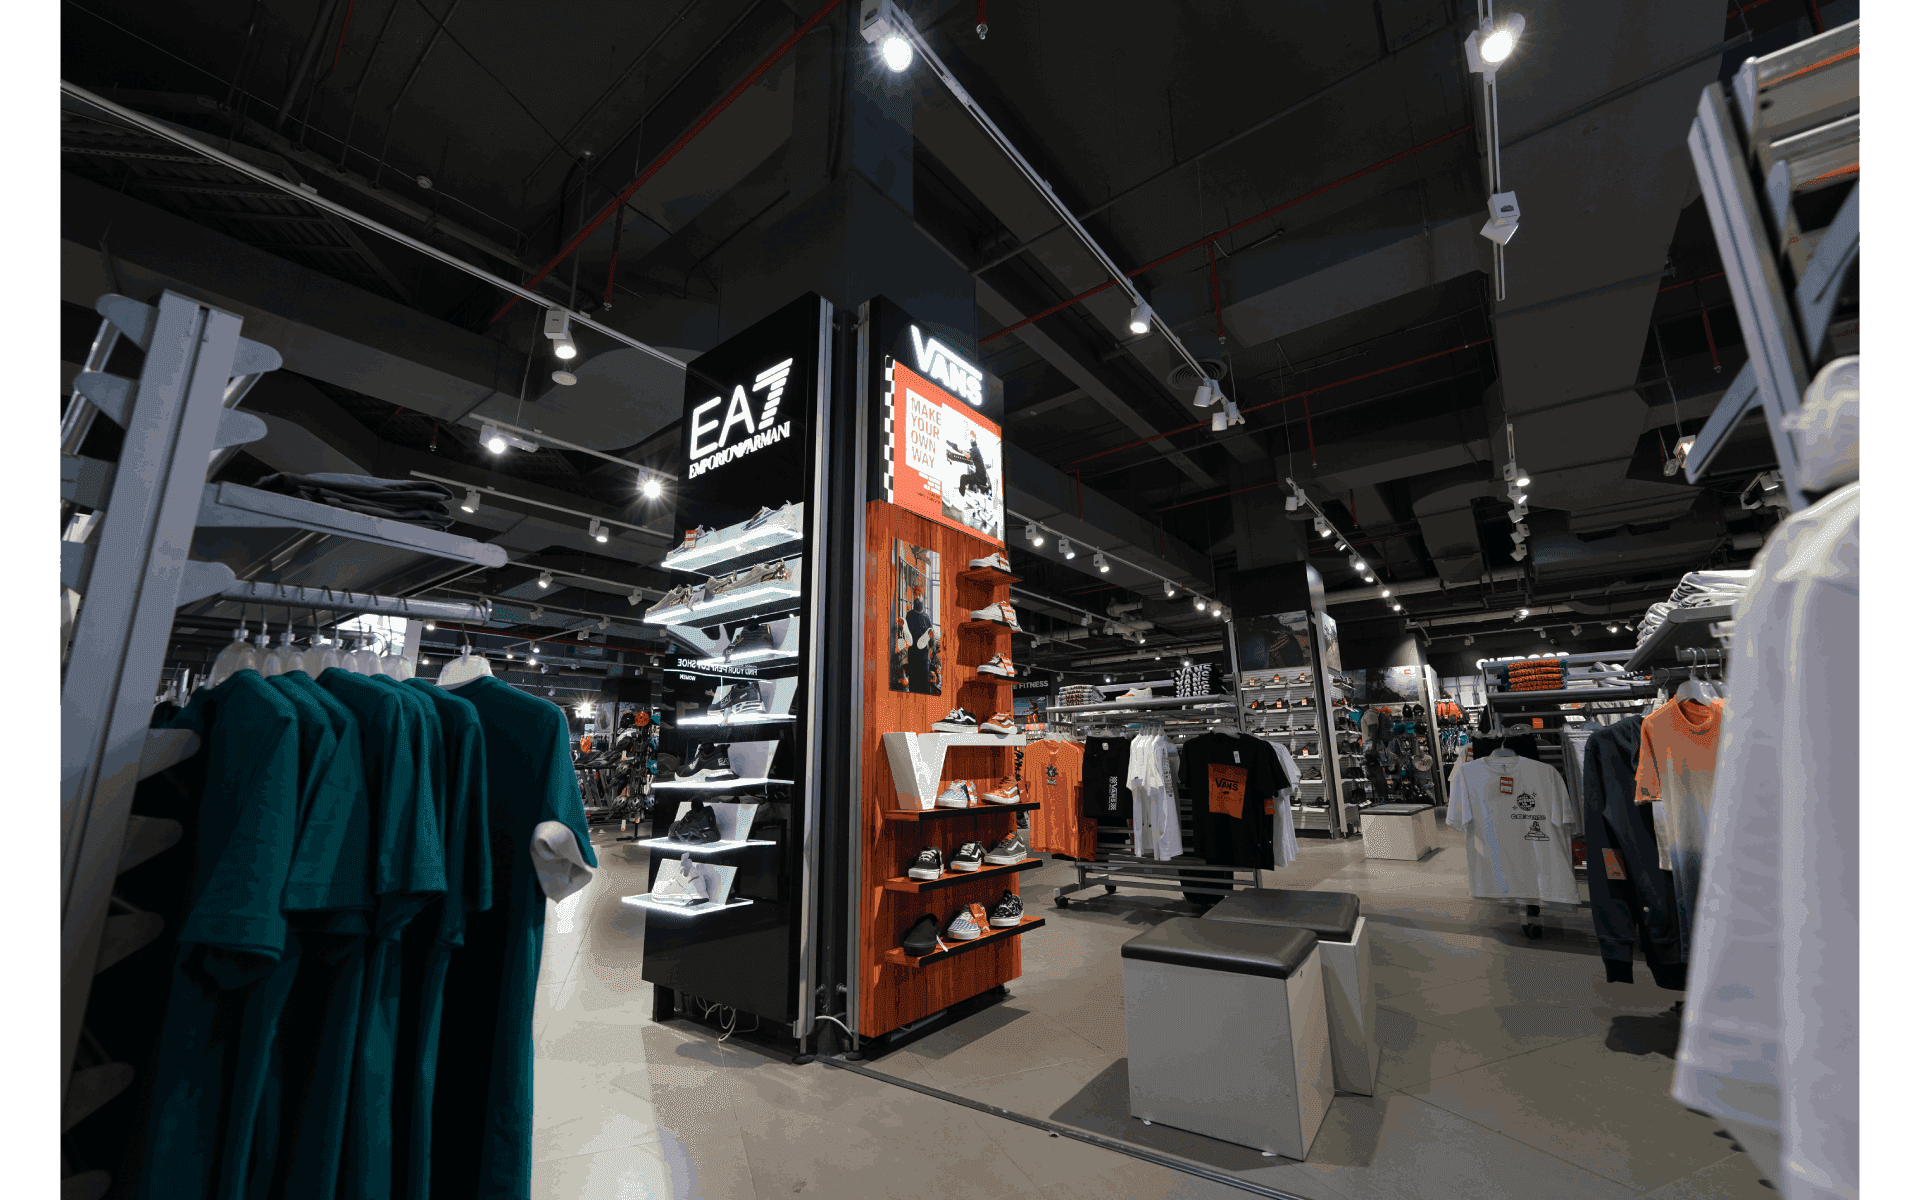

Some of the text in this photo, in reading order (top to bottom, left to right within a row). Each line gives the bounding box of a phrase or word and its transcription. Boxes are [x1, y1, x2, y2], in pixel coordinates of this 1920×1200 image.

[911, 324, 983, 406] VANS
[690, 357, 793, 460] EA7
[911, 397, 941, 426] MAKE
[911, 413, 940, 440] YOUR
[911, 430, 936, 454] OWN
[911, 446, 935, 468] WAY
[1508, 659, 1559, 670] CONVERSE
[1019, 680, 1049, 689] FITNESS
[1215, 777, 1240, 792] VANS
